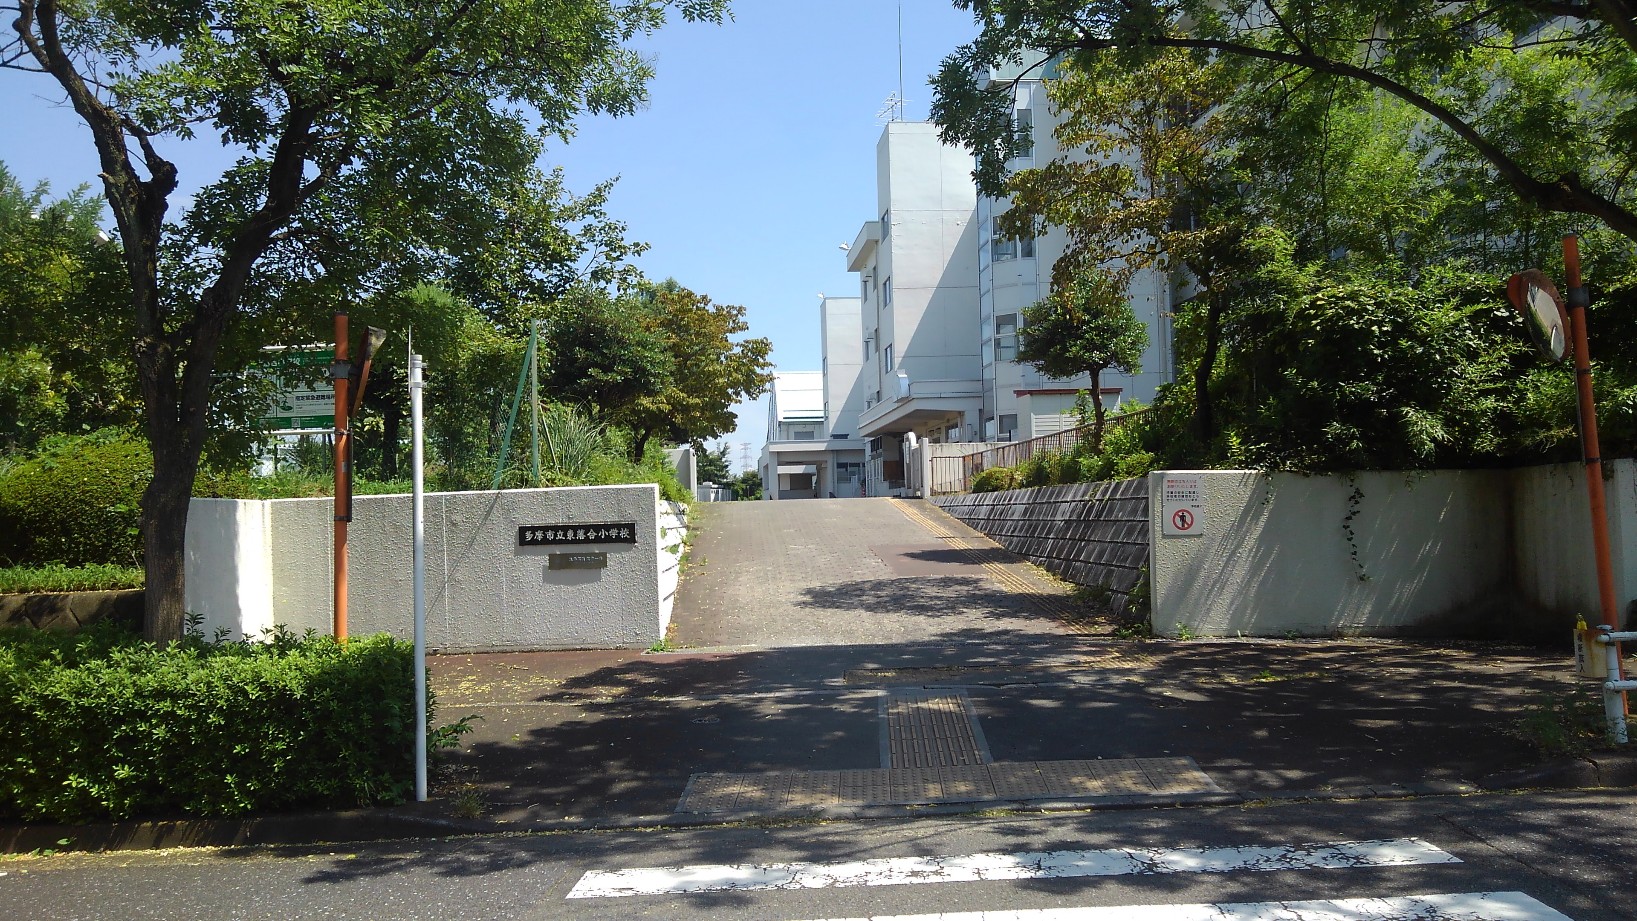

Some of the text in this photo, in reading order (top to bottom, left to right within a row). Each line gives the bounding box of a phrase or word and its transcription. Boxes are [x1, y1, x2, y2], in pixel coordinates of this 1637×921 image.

[524, 527, 631, 541] 多摩市立東落合小学校
